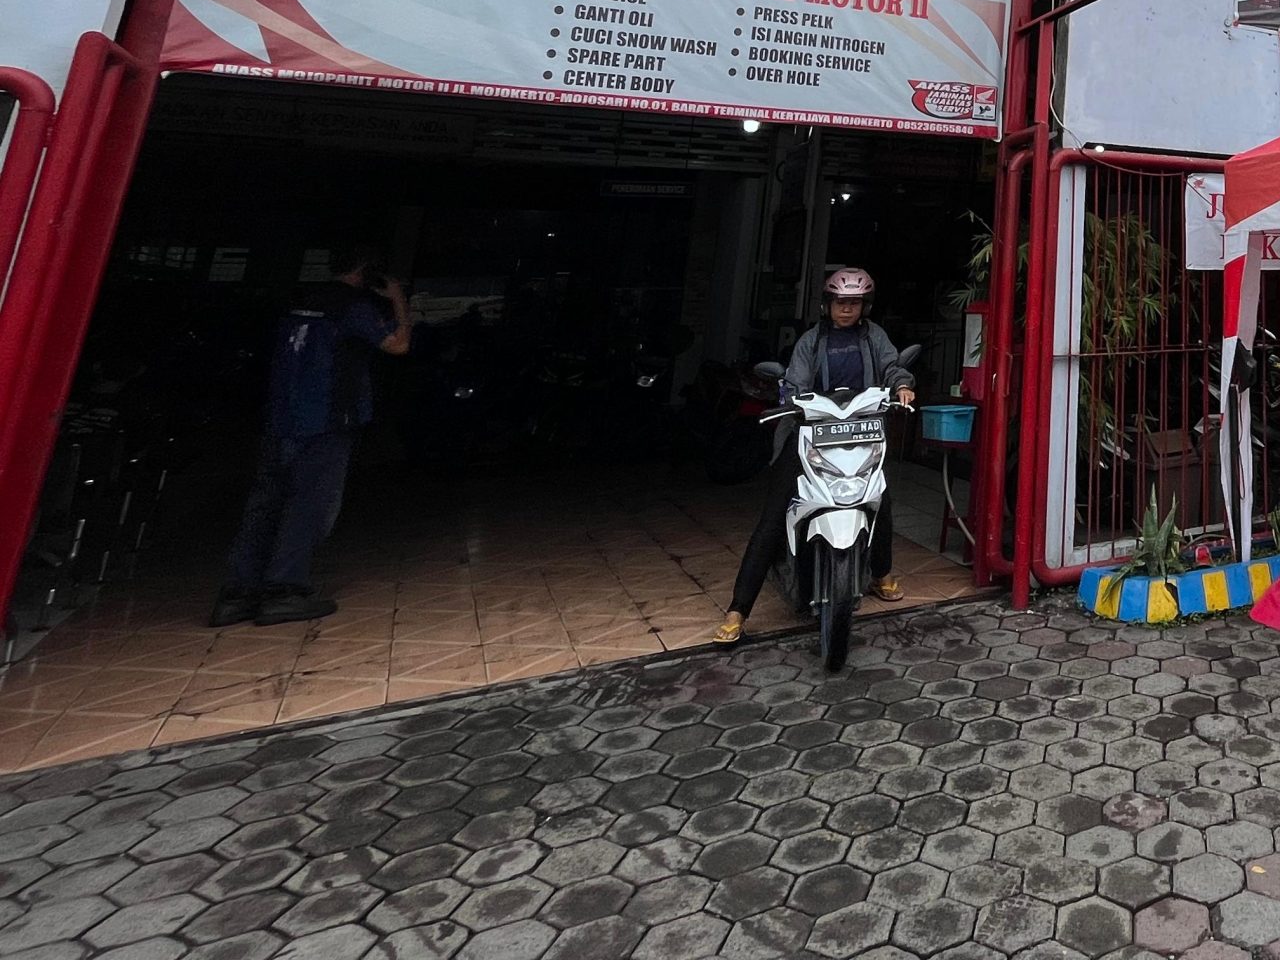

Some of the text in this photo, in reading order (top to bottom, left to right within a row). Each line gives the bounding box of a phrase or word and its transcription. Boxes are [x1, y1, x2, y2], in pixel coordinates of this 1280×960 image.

[574, 5, 654, 28] GANTI OLI
[753, 6, 834, 30] PRESS PELK
[570, 27, 718, 57] CUCI SNOW WASH
[750, 26, 885, 56] ISI ANGIN NITROGEN
[567, 47, 666, 72] SPARE PART
[748, 47, 871, 73] BOOKING SERVICE
[563, 69, 675, 94] CENTER BODY
[745, 66, 821, 87] OVER HOLE
[915, 81, 971, 93] AHASS
[212, 63, 274, 79] AHASS
[276, 68, 375, 87] MOJOPAHIT
[377, 77, 435, 93] MOTOR
[672, 102, 711, 116] BARAT
[712, 106, 771, 120] TERMINAL
[772, 110, 831, 124] KERTAJAYA
[832, 114, 893, 128] MOJOKERTO
[925, 97, 972, 107] KUALITAS
[927, 90, 972, 101] JAMINAN
[936, 104, 971, 114] SERVIS
[816, 427, 823, 435] S
[830, 424, 855, 434] 6307
